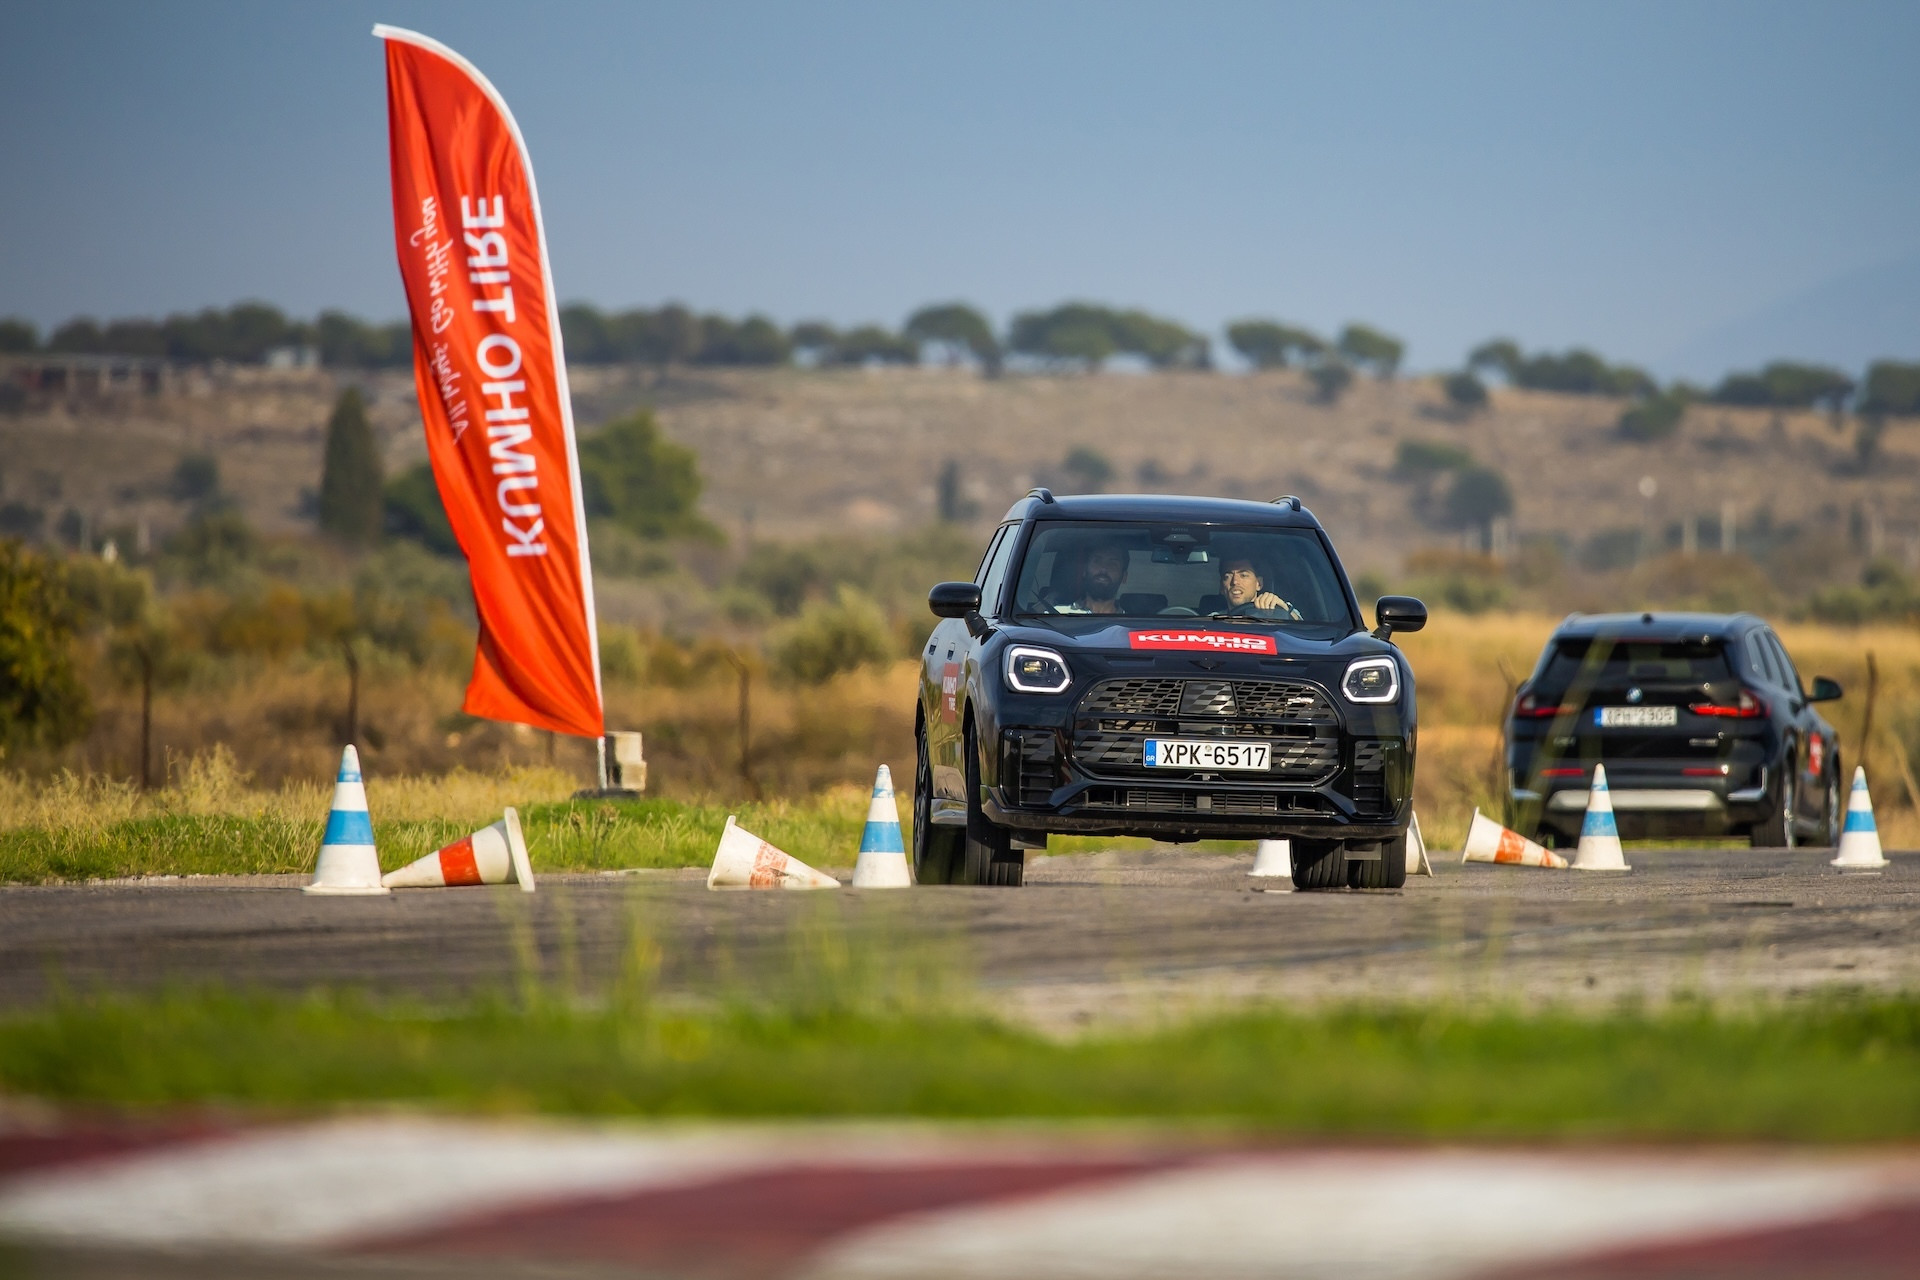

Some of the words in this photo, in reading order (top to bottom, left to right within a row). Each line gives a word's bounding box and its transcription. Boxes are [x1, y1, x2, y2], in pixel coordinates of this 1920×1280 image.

[1138, 634, 1267, 645] KUMHO
[1207, 642, 1267, 650] TIRE
[1163, 744, 1267, 767] XPK-6517
